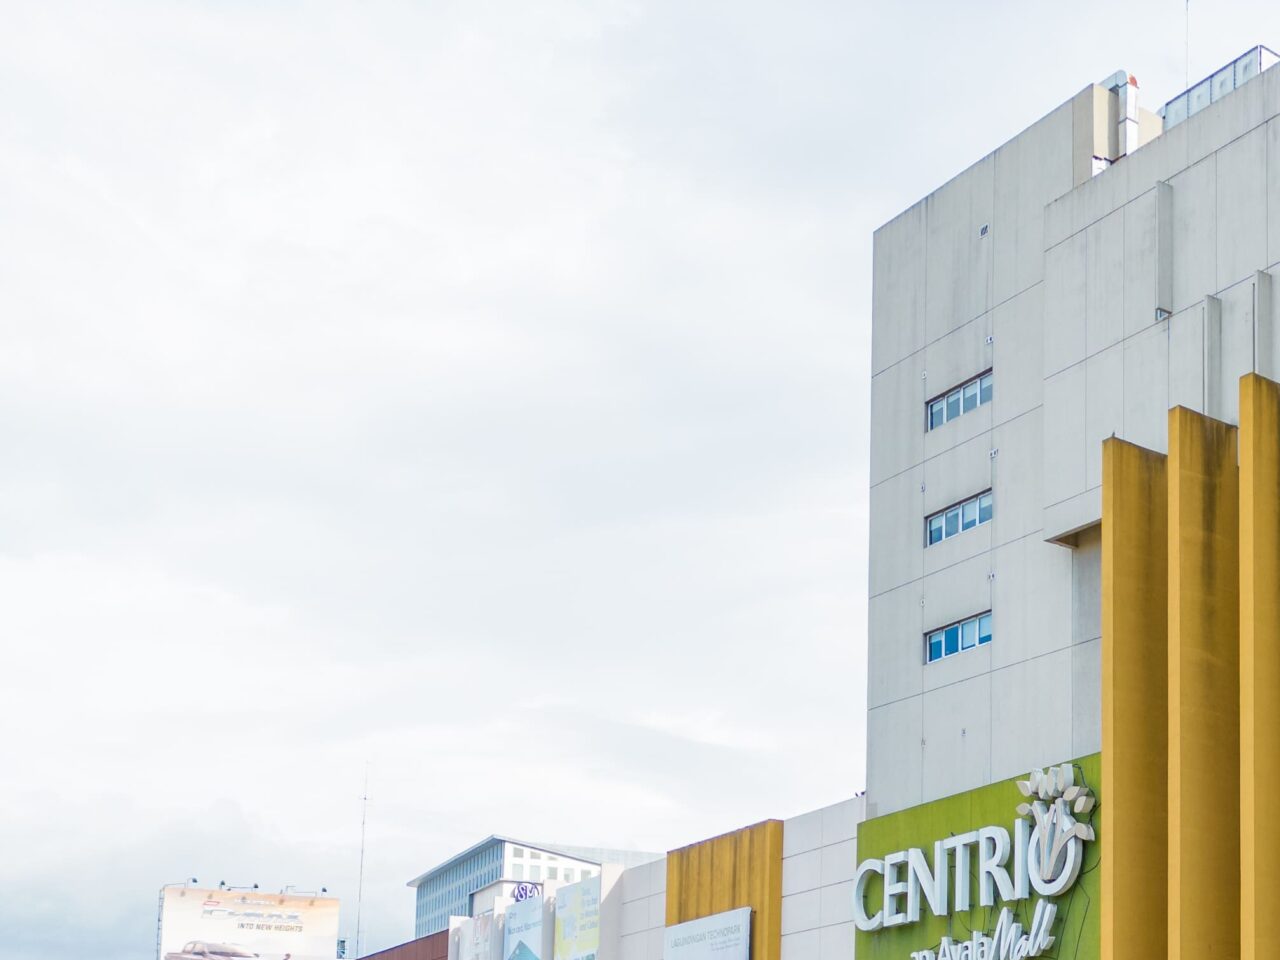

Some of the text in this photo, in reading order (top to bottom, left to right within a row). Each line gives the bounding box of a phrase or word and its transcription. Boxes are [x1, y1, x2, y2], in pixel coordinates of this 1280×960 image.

[853, 796, 1086, 932] CENTRIO
[237, 922, 304, 933] INTO NEW HEIGHTS
